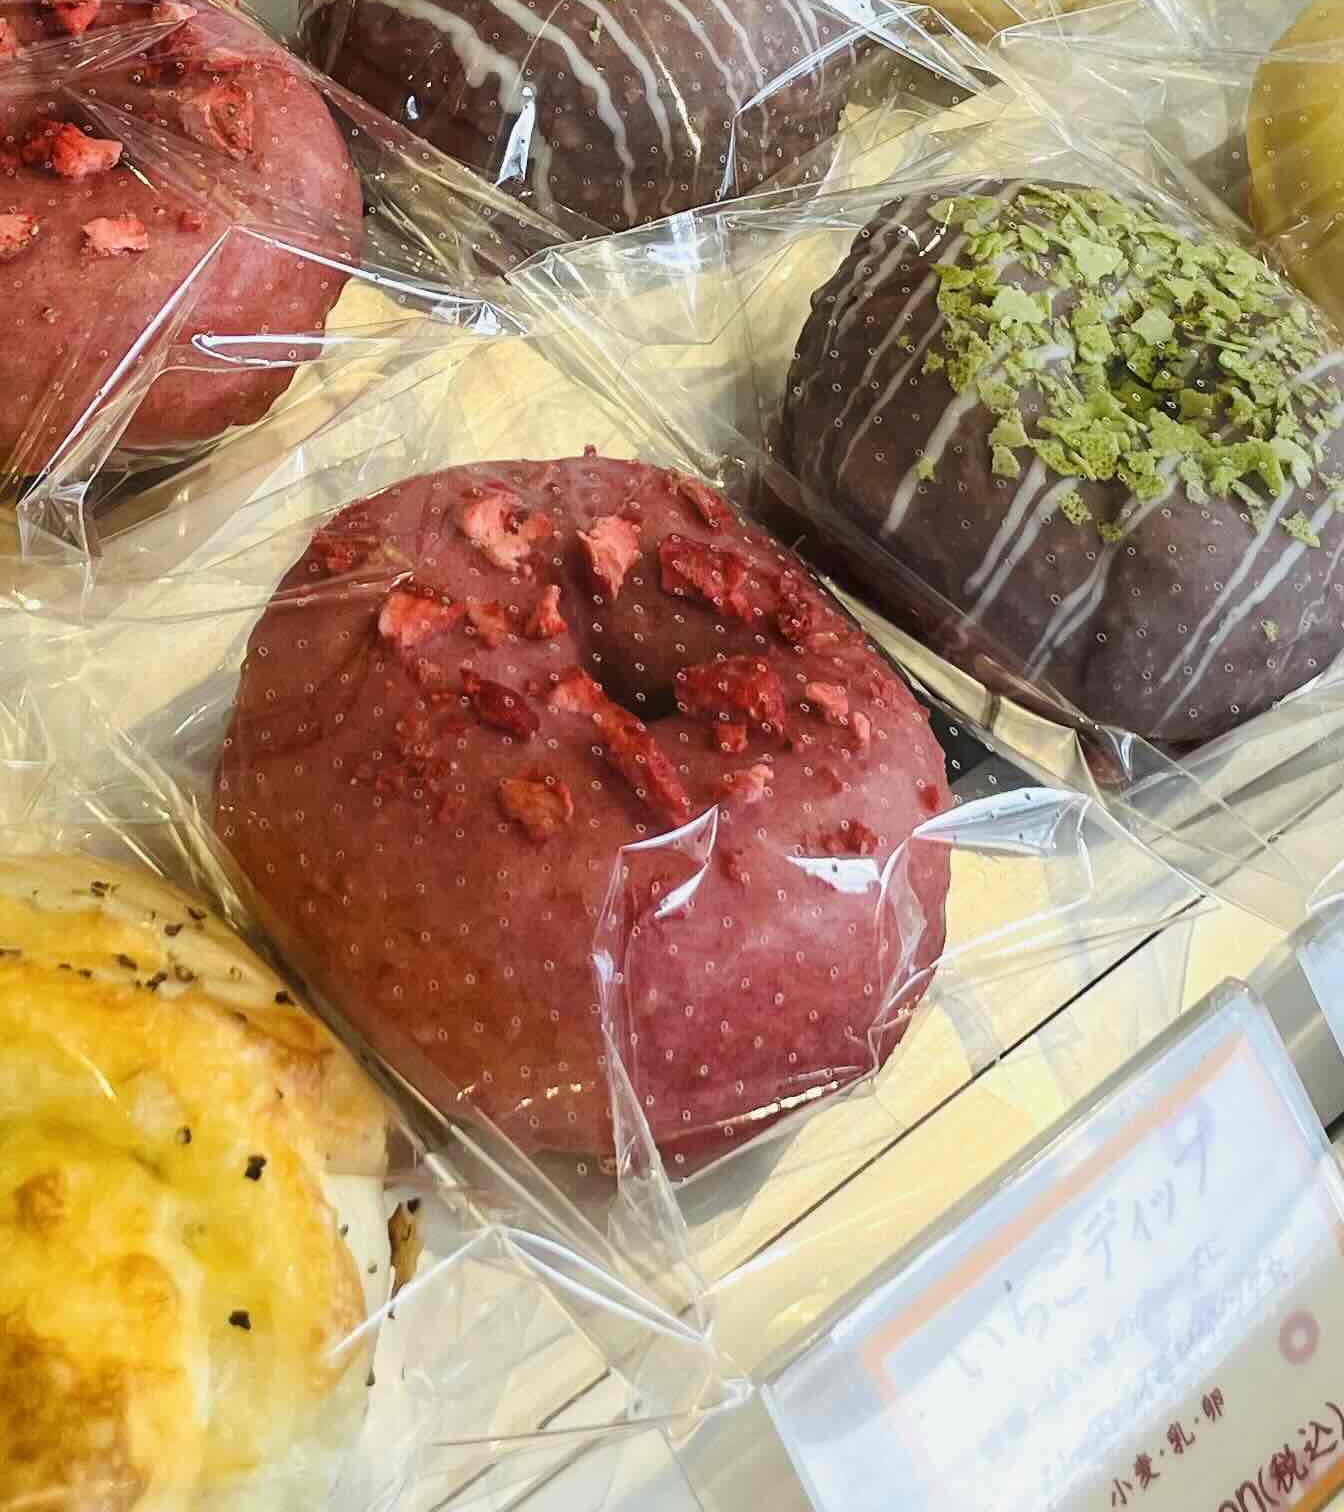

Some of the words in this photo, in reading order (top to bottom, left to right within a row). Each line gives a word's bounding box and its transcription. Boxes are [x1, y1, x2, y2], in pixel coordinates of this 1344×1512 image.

[1107, 1384, 1226, 1508] 小麦・乳・卵
